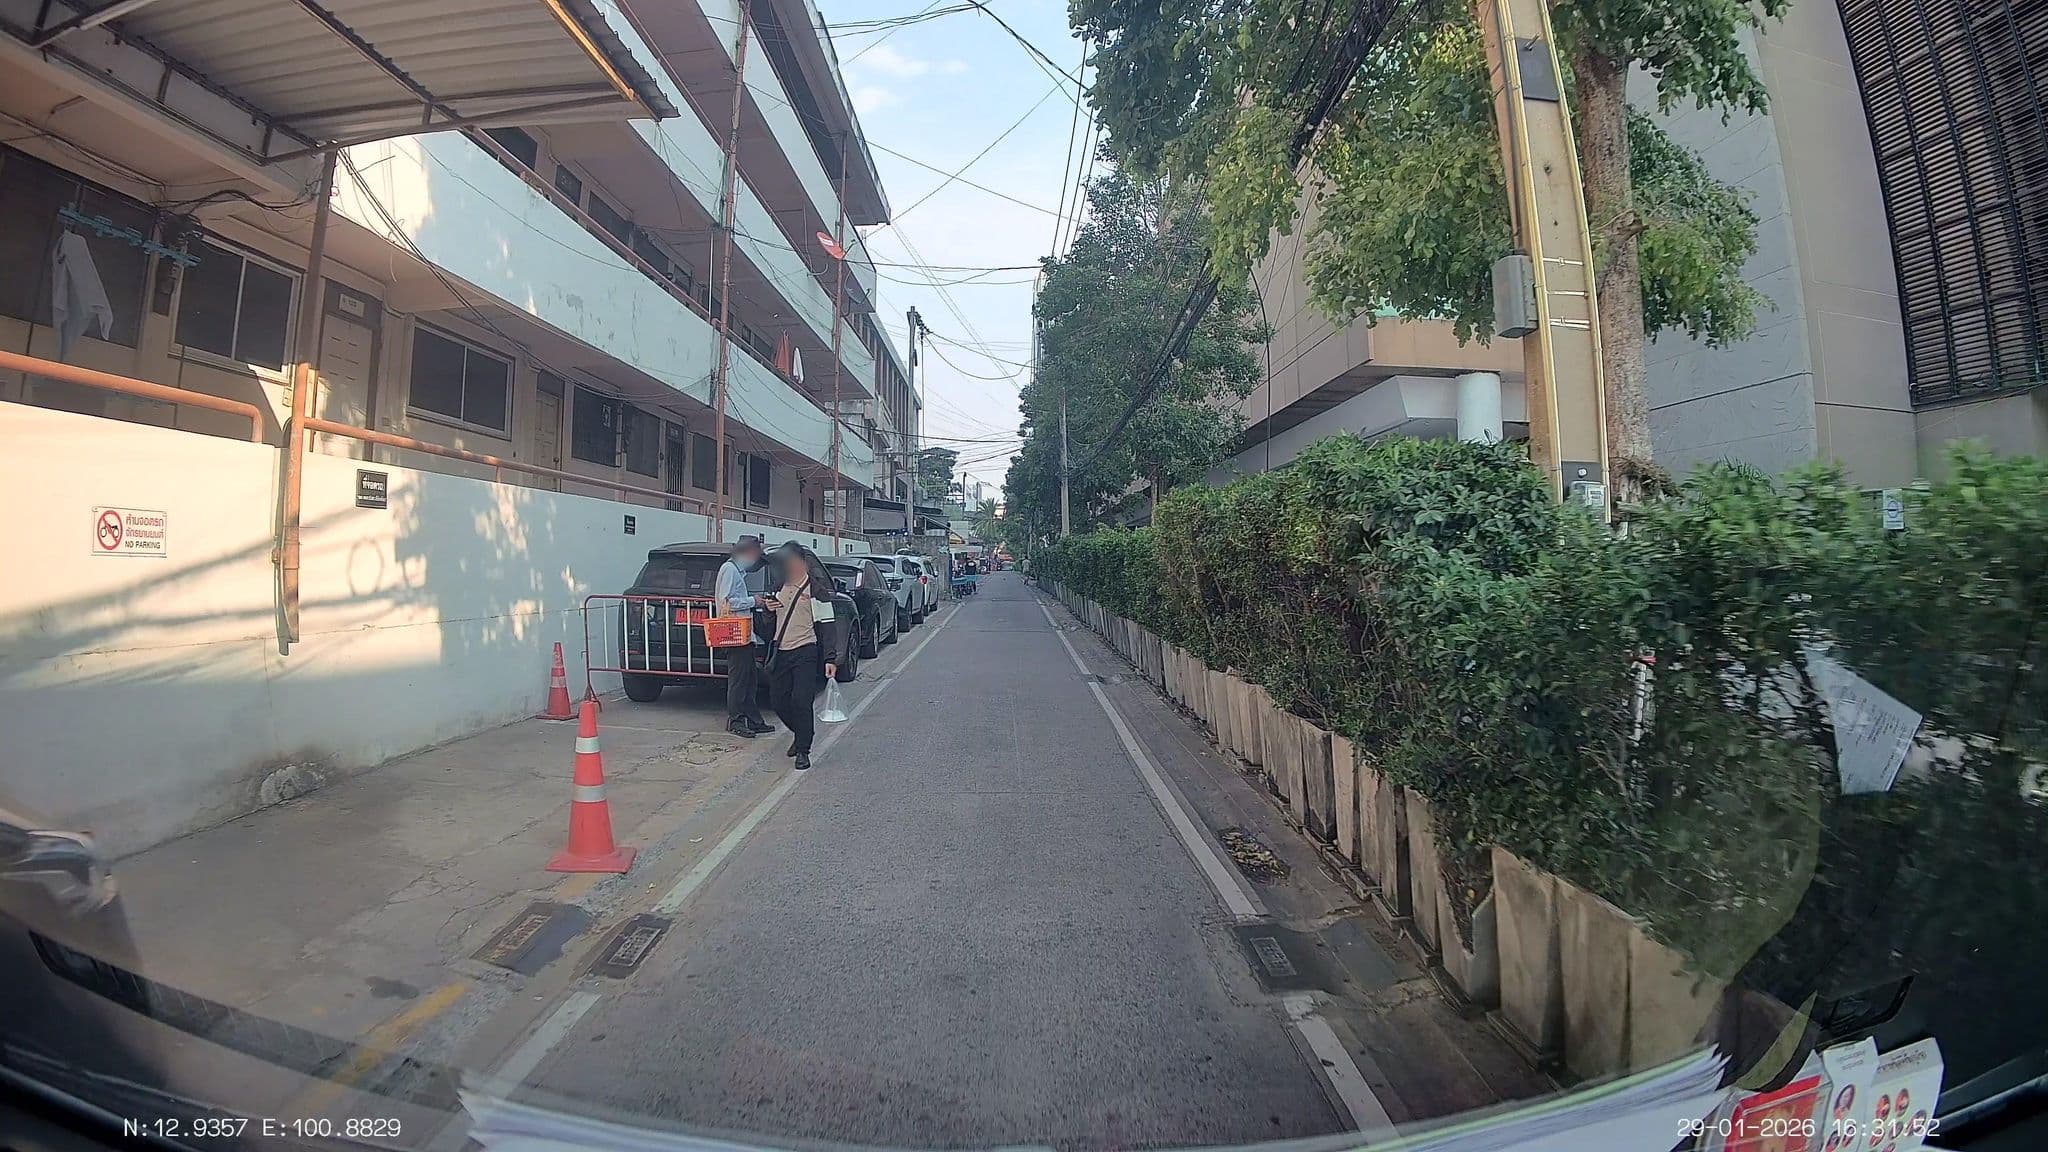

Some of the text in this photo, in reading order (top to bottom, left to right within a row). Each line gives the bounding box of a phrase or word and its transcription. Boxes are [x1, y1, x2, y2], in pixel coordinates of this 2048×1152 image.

[125, 513, 164, 527] ห้ามจอดรถ
[125, 527, 164, 539] จักรยานยนต์
[125, 540, 161, 549] NO PARKING
